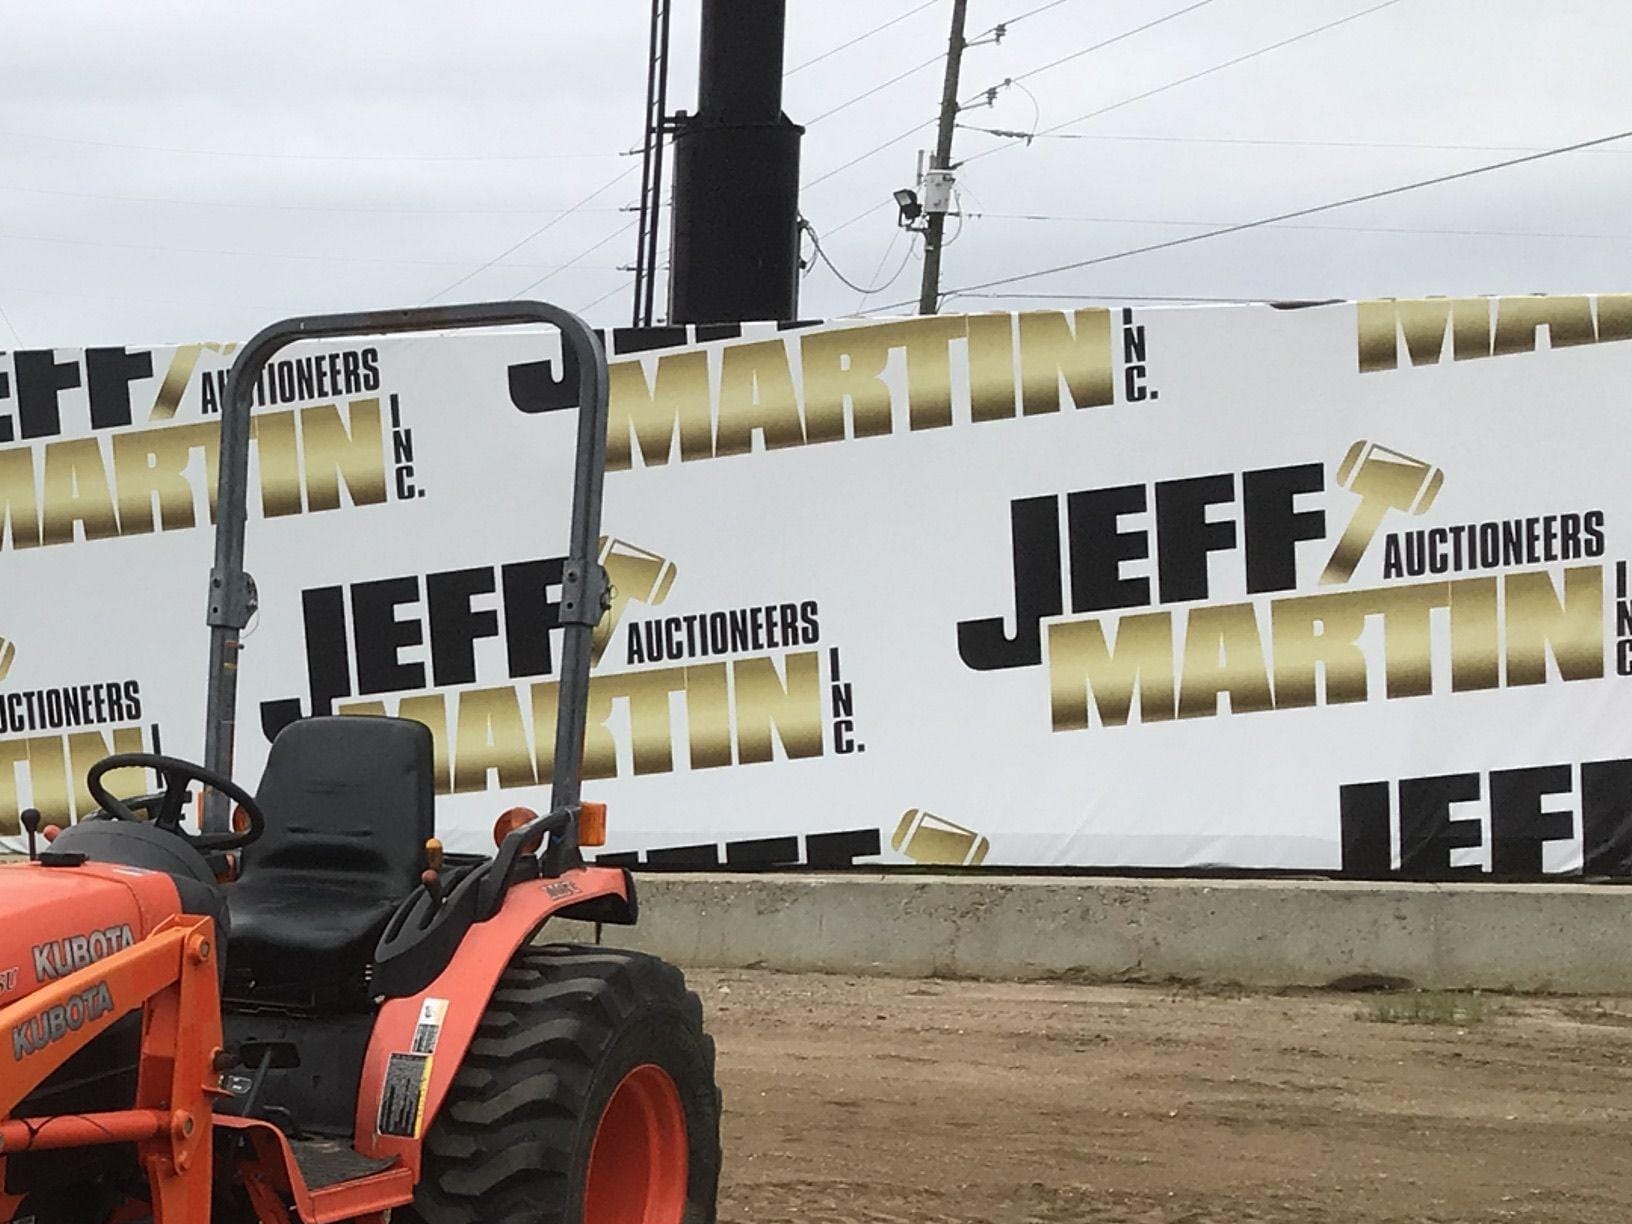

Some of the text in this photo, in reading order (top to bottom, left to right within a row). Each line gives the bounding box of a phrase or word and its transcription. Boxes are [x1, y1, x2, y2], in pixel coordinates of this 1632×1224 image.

[202, 347, 380, 414] ATIONEERS
[602, 308, 1114, 472] MARTIN
[957, 463, 1326, 671] JEFF
[1384, 511, 1604, 579] AUCTIONEERS
[260, 556, 568, 744] JEFF
[627, 600, 820, 665] AUCTIONEERS
[1048, 565, 1604, 733] MARTIN
[32, 923, 135, 983] KUBOTA
[11, 980, 114, 1061] KUBOTA
